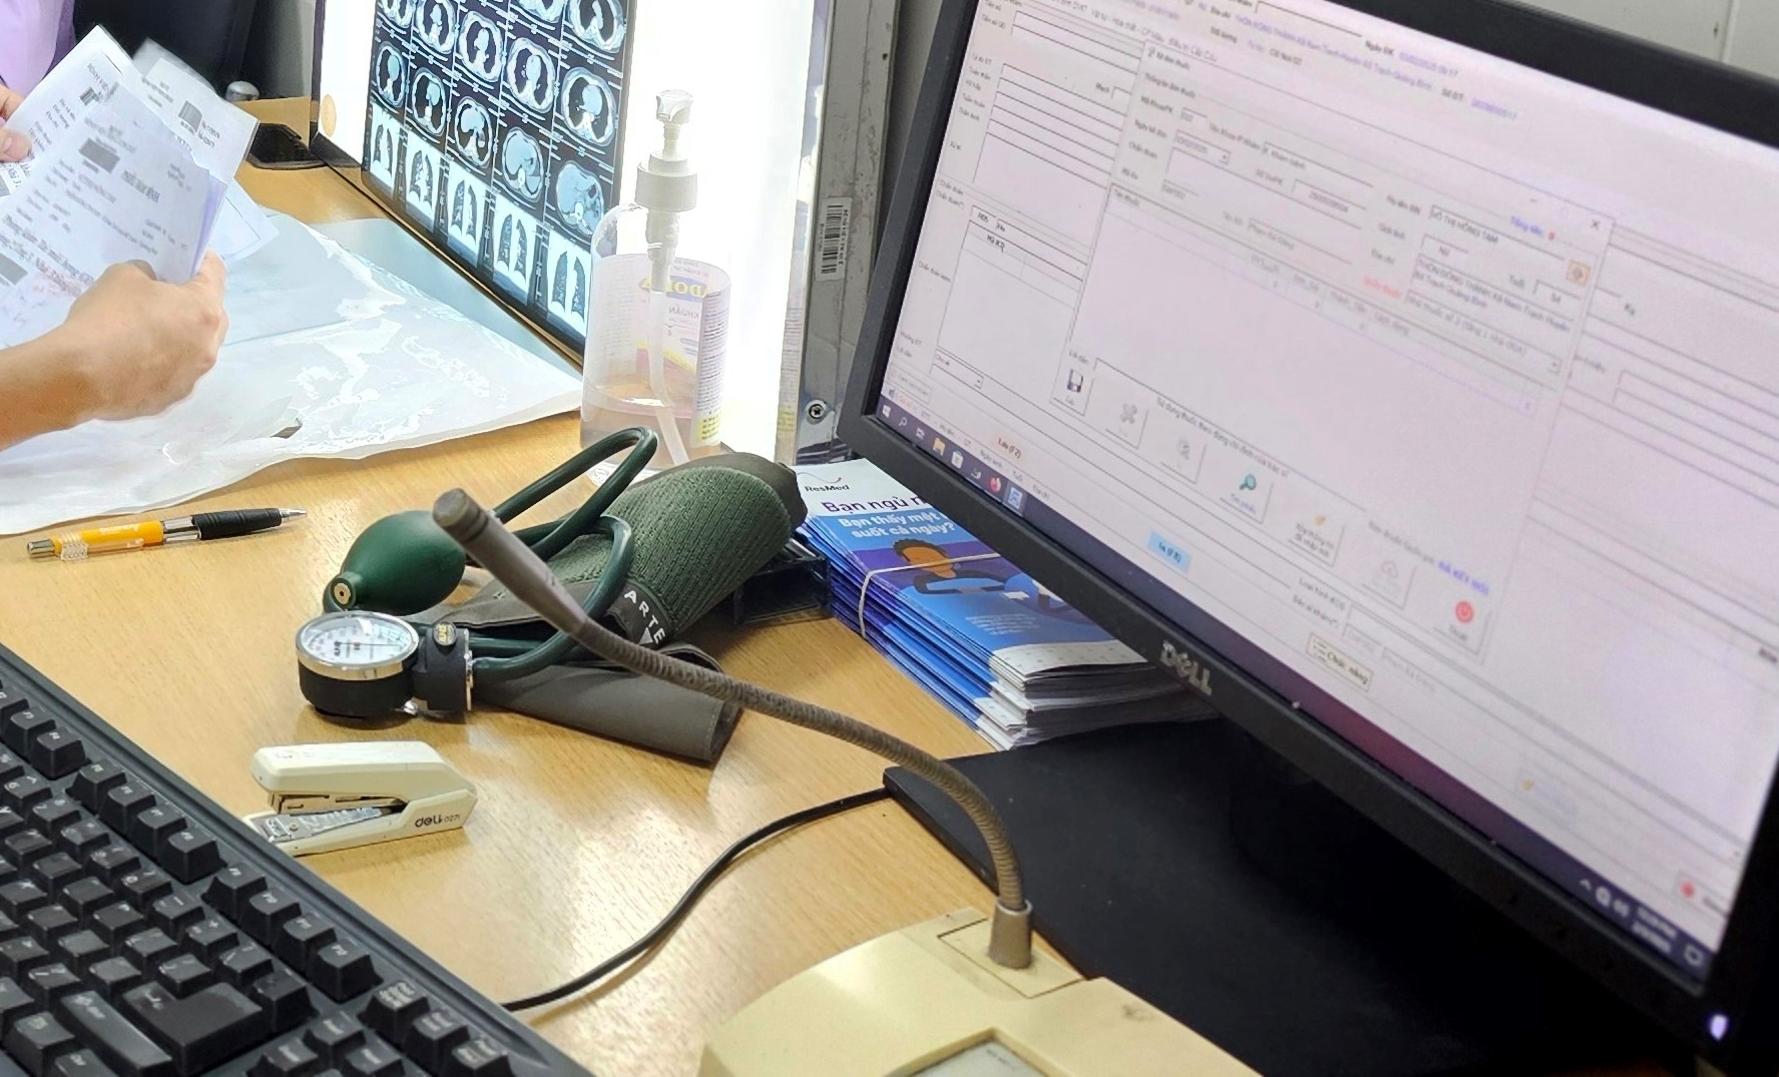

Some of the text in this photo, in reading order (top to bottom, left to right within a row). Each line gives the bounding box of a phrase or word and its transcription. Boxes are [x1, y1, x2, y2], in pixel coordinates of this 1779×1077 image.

[805, 484, 850, 492] ResMed
[821, 501, 867, 514] Bạn
[867, 496, 909, 511] ngủ
[838, 512, 939, 529] Bạn thấy một
[851, 521, 955, 538] suốt cả ngày?
[1160, 640, 1212, 696] DELL
[415, 814, 442, 828] deli
